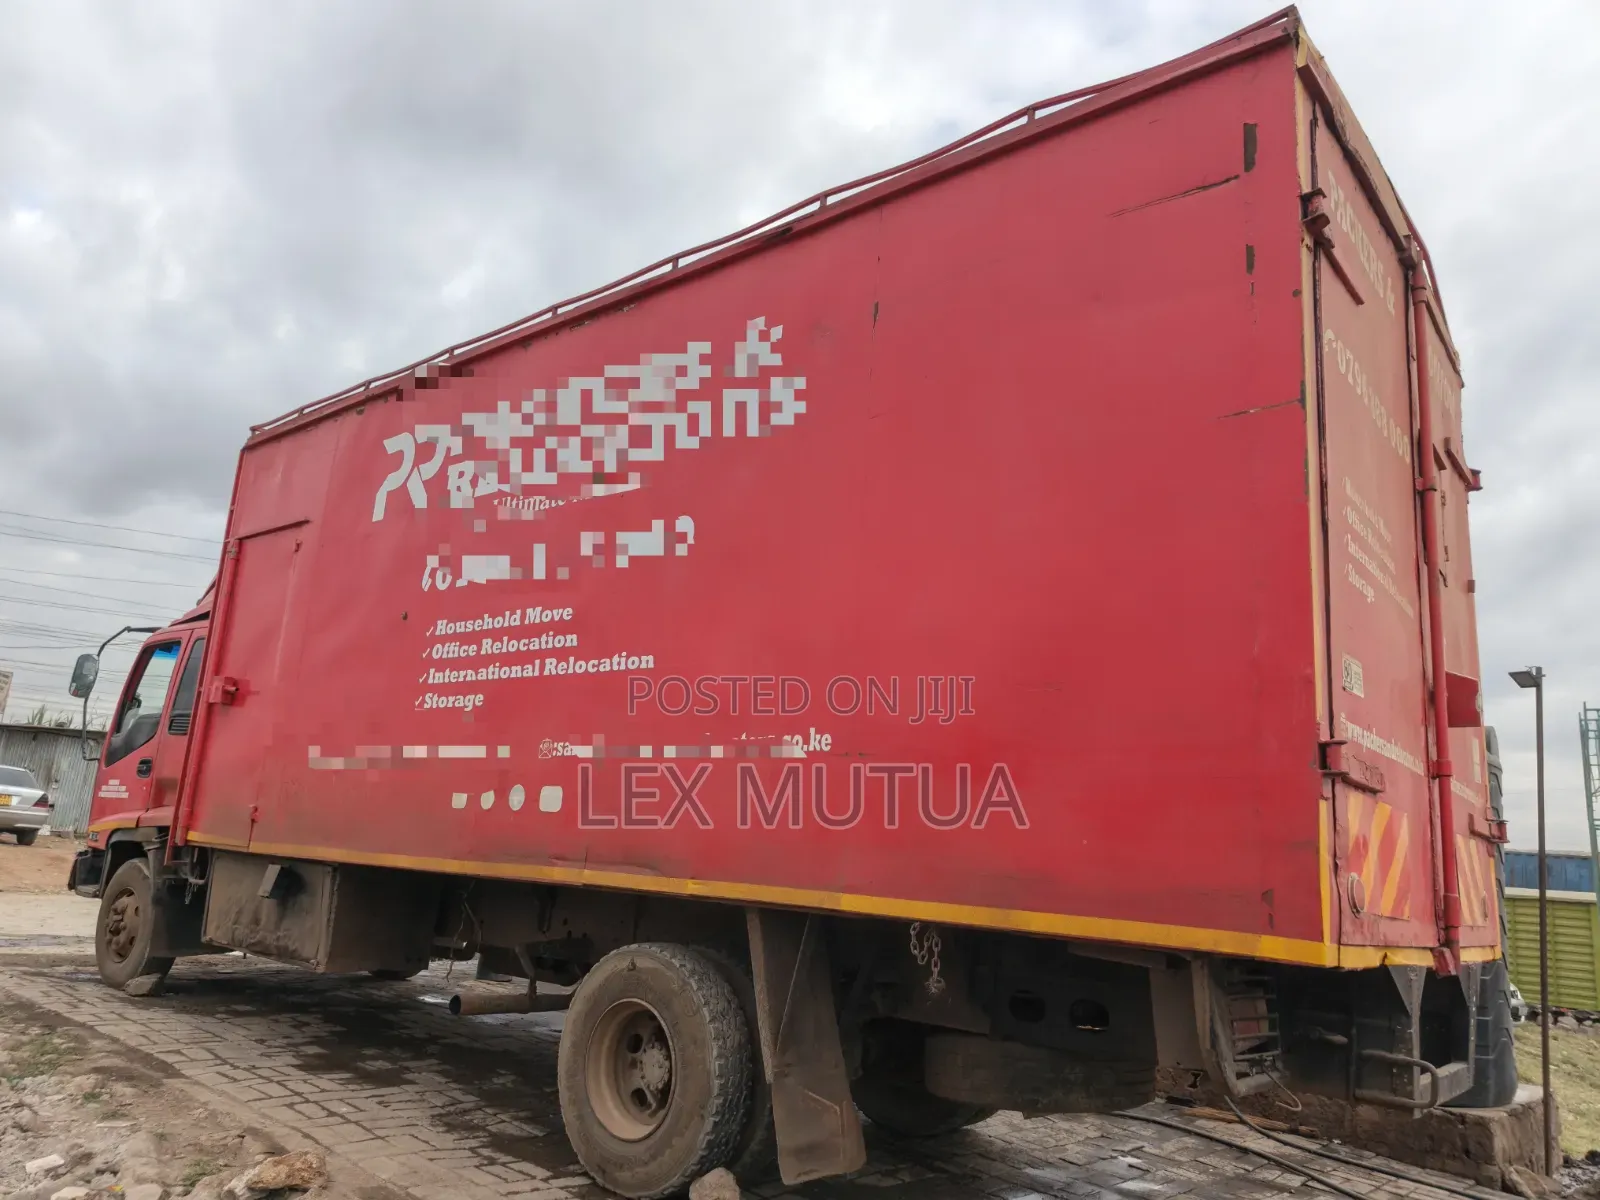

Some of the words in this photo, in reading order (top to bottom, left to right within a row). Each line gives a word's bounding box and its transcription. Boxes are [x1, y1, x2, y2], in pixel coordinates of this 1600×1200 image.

[435, 609, 521, 636] Household
[524, 606, 573, 625] Move
[432, 643, 477, 660] Office
[481, 631, 578, 655] Relocation
[427, 659, 540, 684] International
[544, 652, 654, 676] Relocation
[423, 693, 484, 711] Storage
